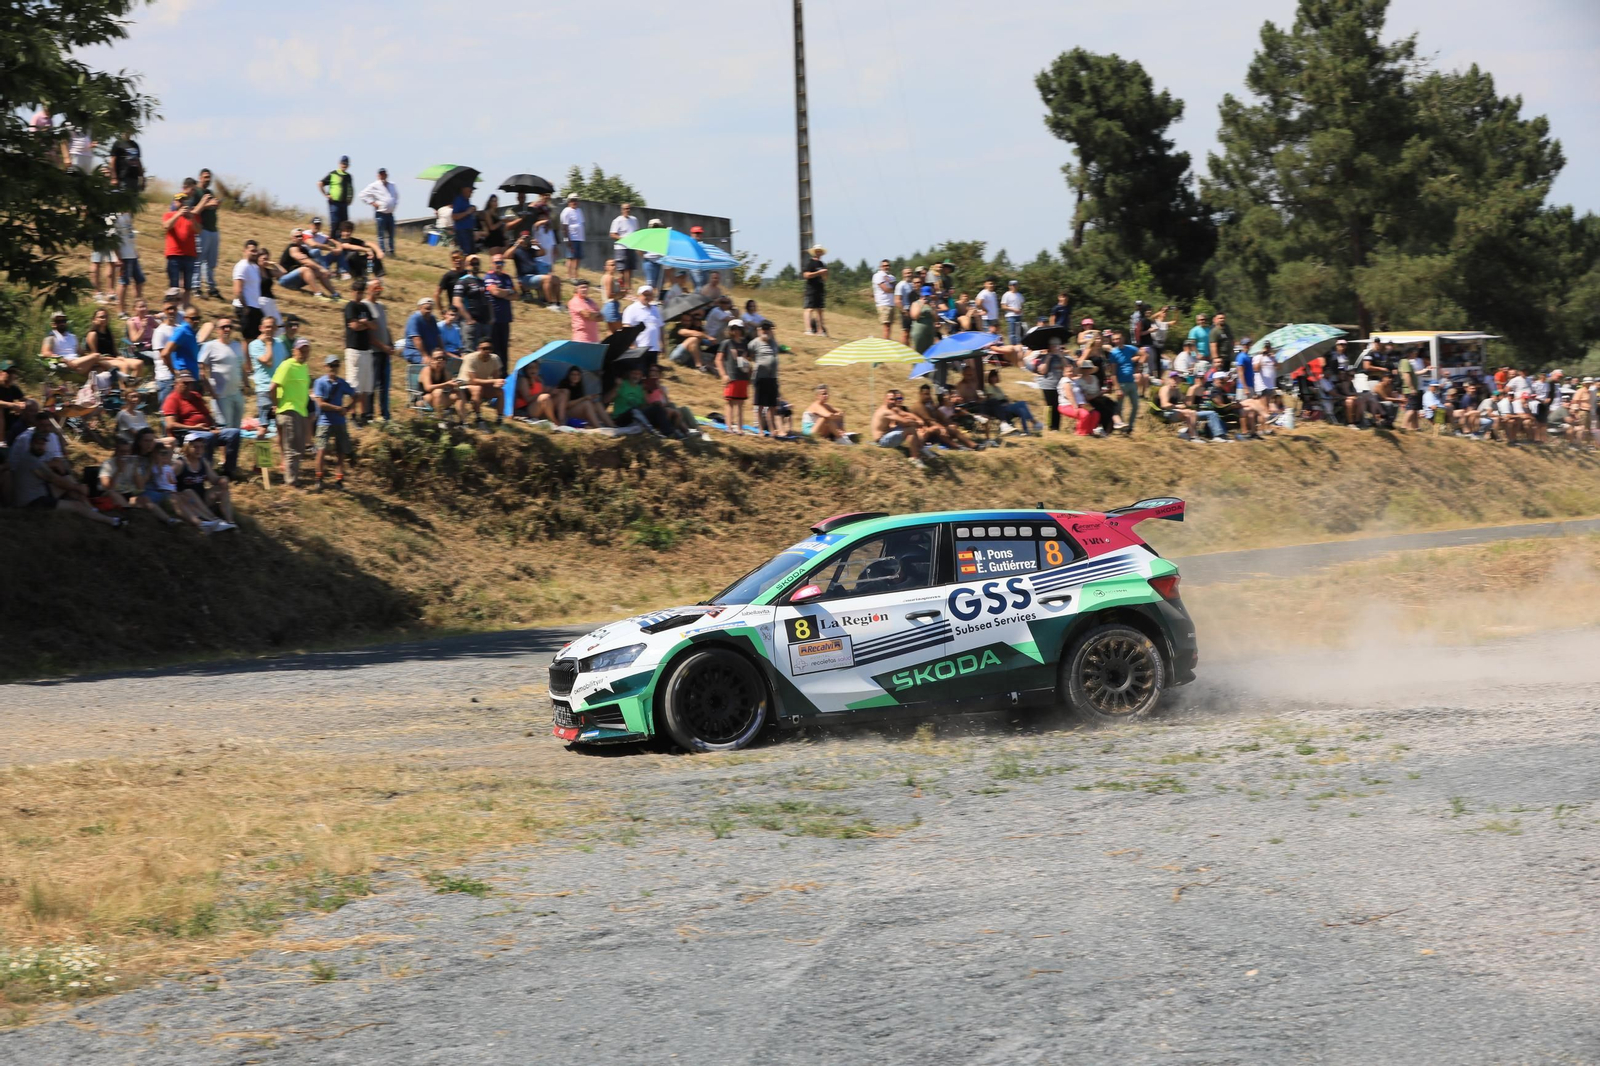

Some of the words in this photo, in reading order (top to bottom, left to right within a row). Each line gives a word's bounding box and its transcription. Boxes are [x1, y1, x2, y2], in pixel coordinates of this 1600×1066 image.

[988, 549, 1014, 560] Pons
[1044, 540, 1064, 566] 8
[977, 563, 988, 574] E.
[989, 560, 1037, 573] Gutiérrez
[948, 577, 1032, 621] GSS
[794, 619, 811, 639] 8
[820, 619, 839, 630] La
[955, 622, 993, 636] Subsea
[995, 613, 1037, 628] Services
[807, 642, 834, 654] Recalvi
